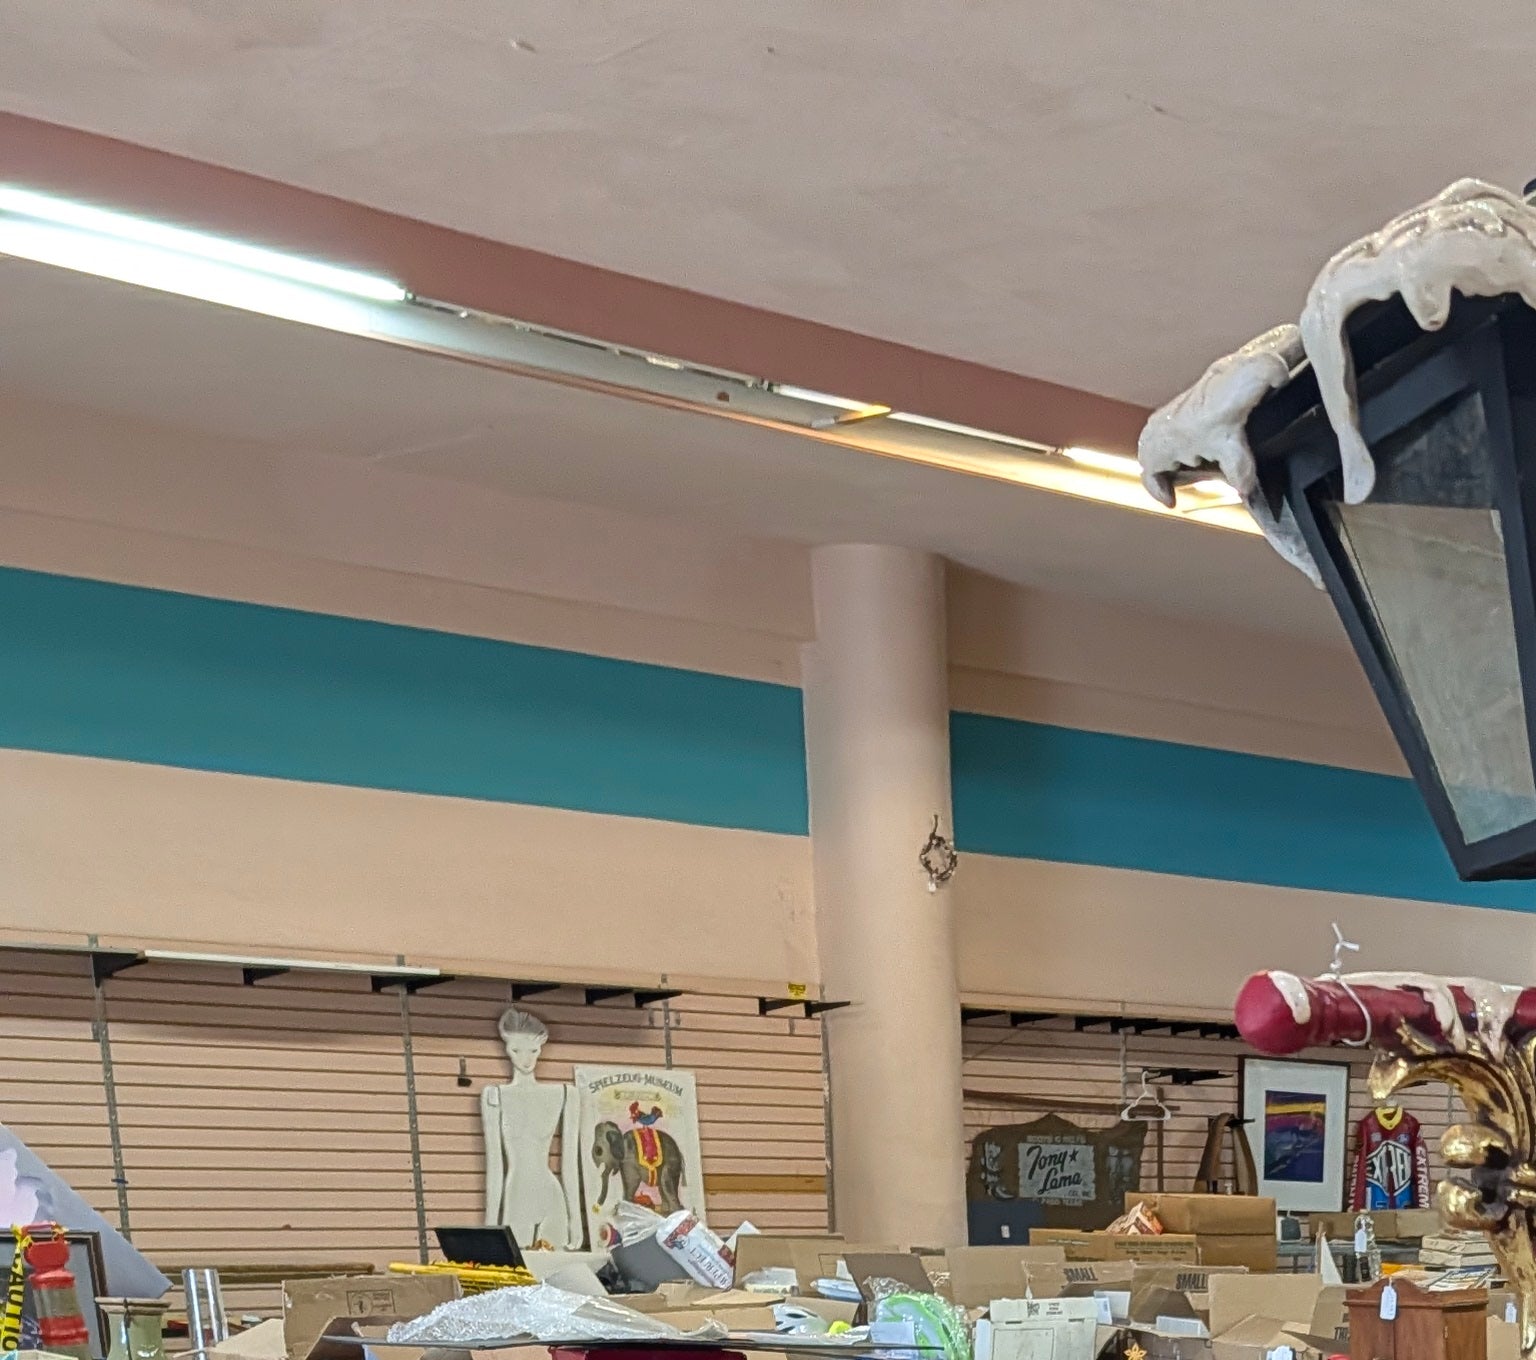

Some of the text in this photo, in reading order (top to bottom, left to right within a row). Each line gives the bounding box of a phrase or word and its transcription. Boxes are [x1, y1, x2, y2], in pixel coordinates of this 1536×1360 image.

[1026, 1145, 1067, 1180] Tony
[1037, 1168, 1082, 1195] Lama
[1063, 1267, 1098, 1283] SMALL
